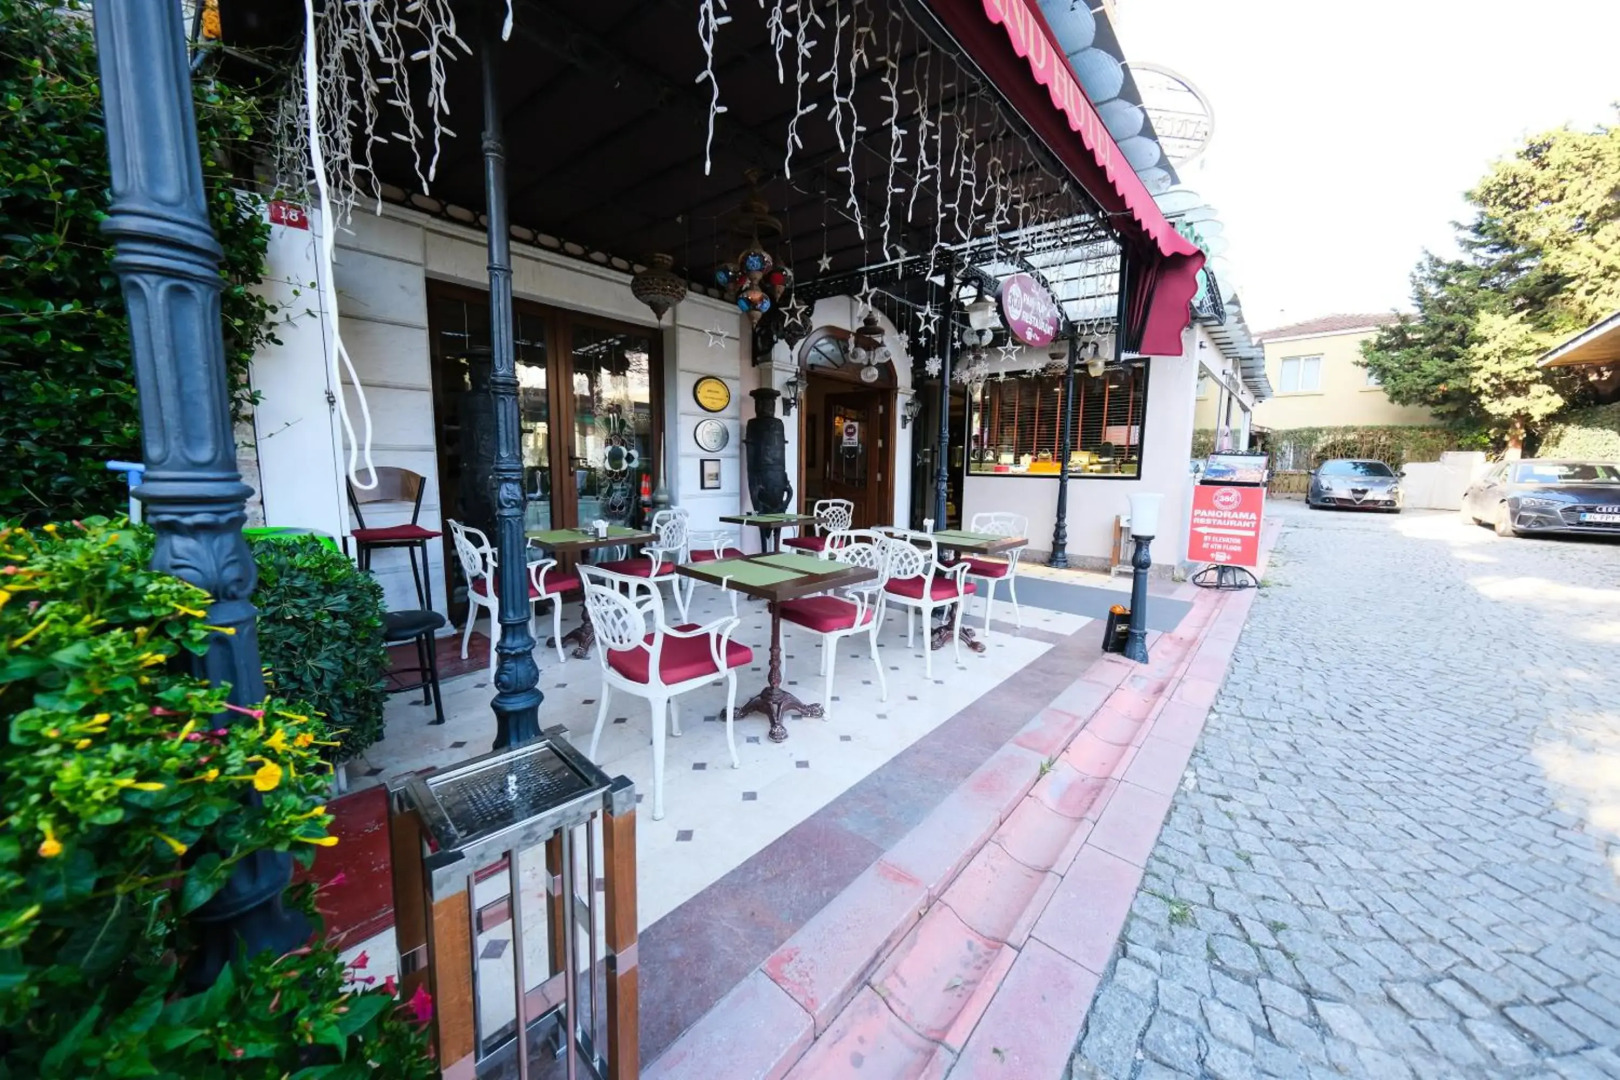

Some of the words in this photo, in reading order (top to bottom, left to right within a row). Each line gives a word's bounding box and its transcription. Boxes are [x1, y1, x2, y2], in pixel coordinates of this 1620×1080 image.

[1053, 54, 1115, 172] HOTEL
[280, 206, 299, 222] 18
[1194, 509, 1257, 520] PANORAMA
[1193, 517, 1257, 528] RESTAURANT
